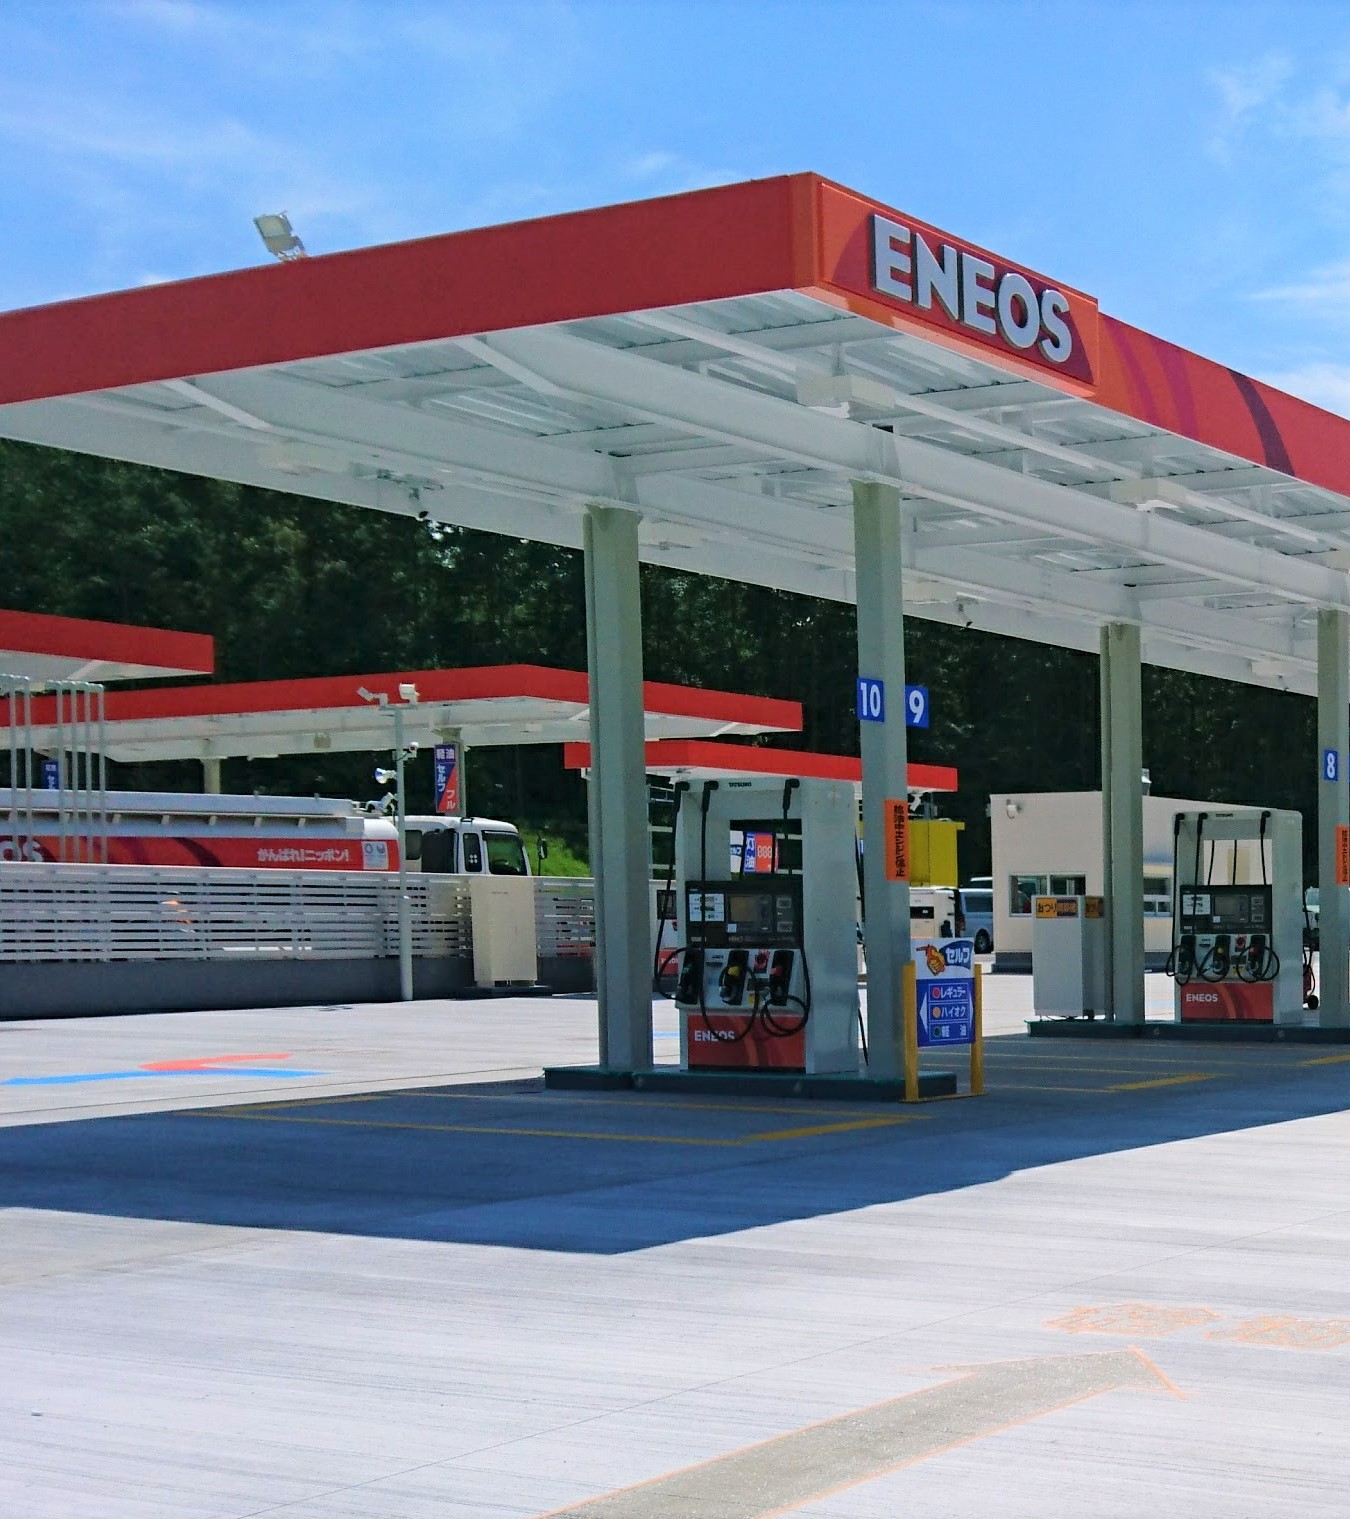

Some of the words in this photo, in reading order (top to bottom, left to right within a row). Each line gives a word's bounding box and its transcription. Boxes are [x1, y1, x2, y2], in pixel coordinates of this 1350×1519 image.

[871, 214, 1073, 363] ENEOS
[860, 682, 881, 718] 10
[909, 690, 924, 723] 9
[1326, 752, 1336, 779] 8
[945, 947, 970, 965] セルフ
[1186, 993, 1218, 1002] ENEOS
[941, 1006, 966, 1018] ハイオク
[694, 1030, 736, 1042] ENEOS
